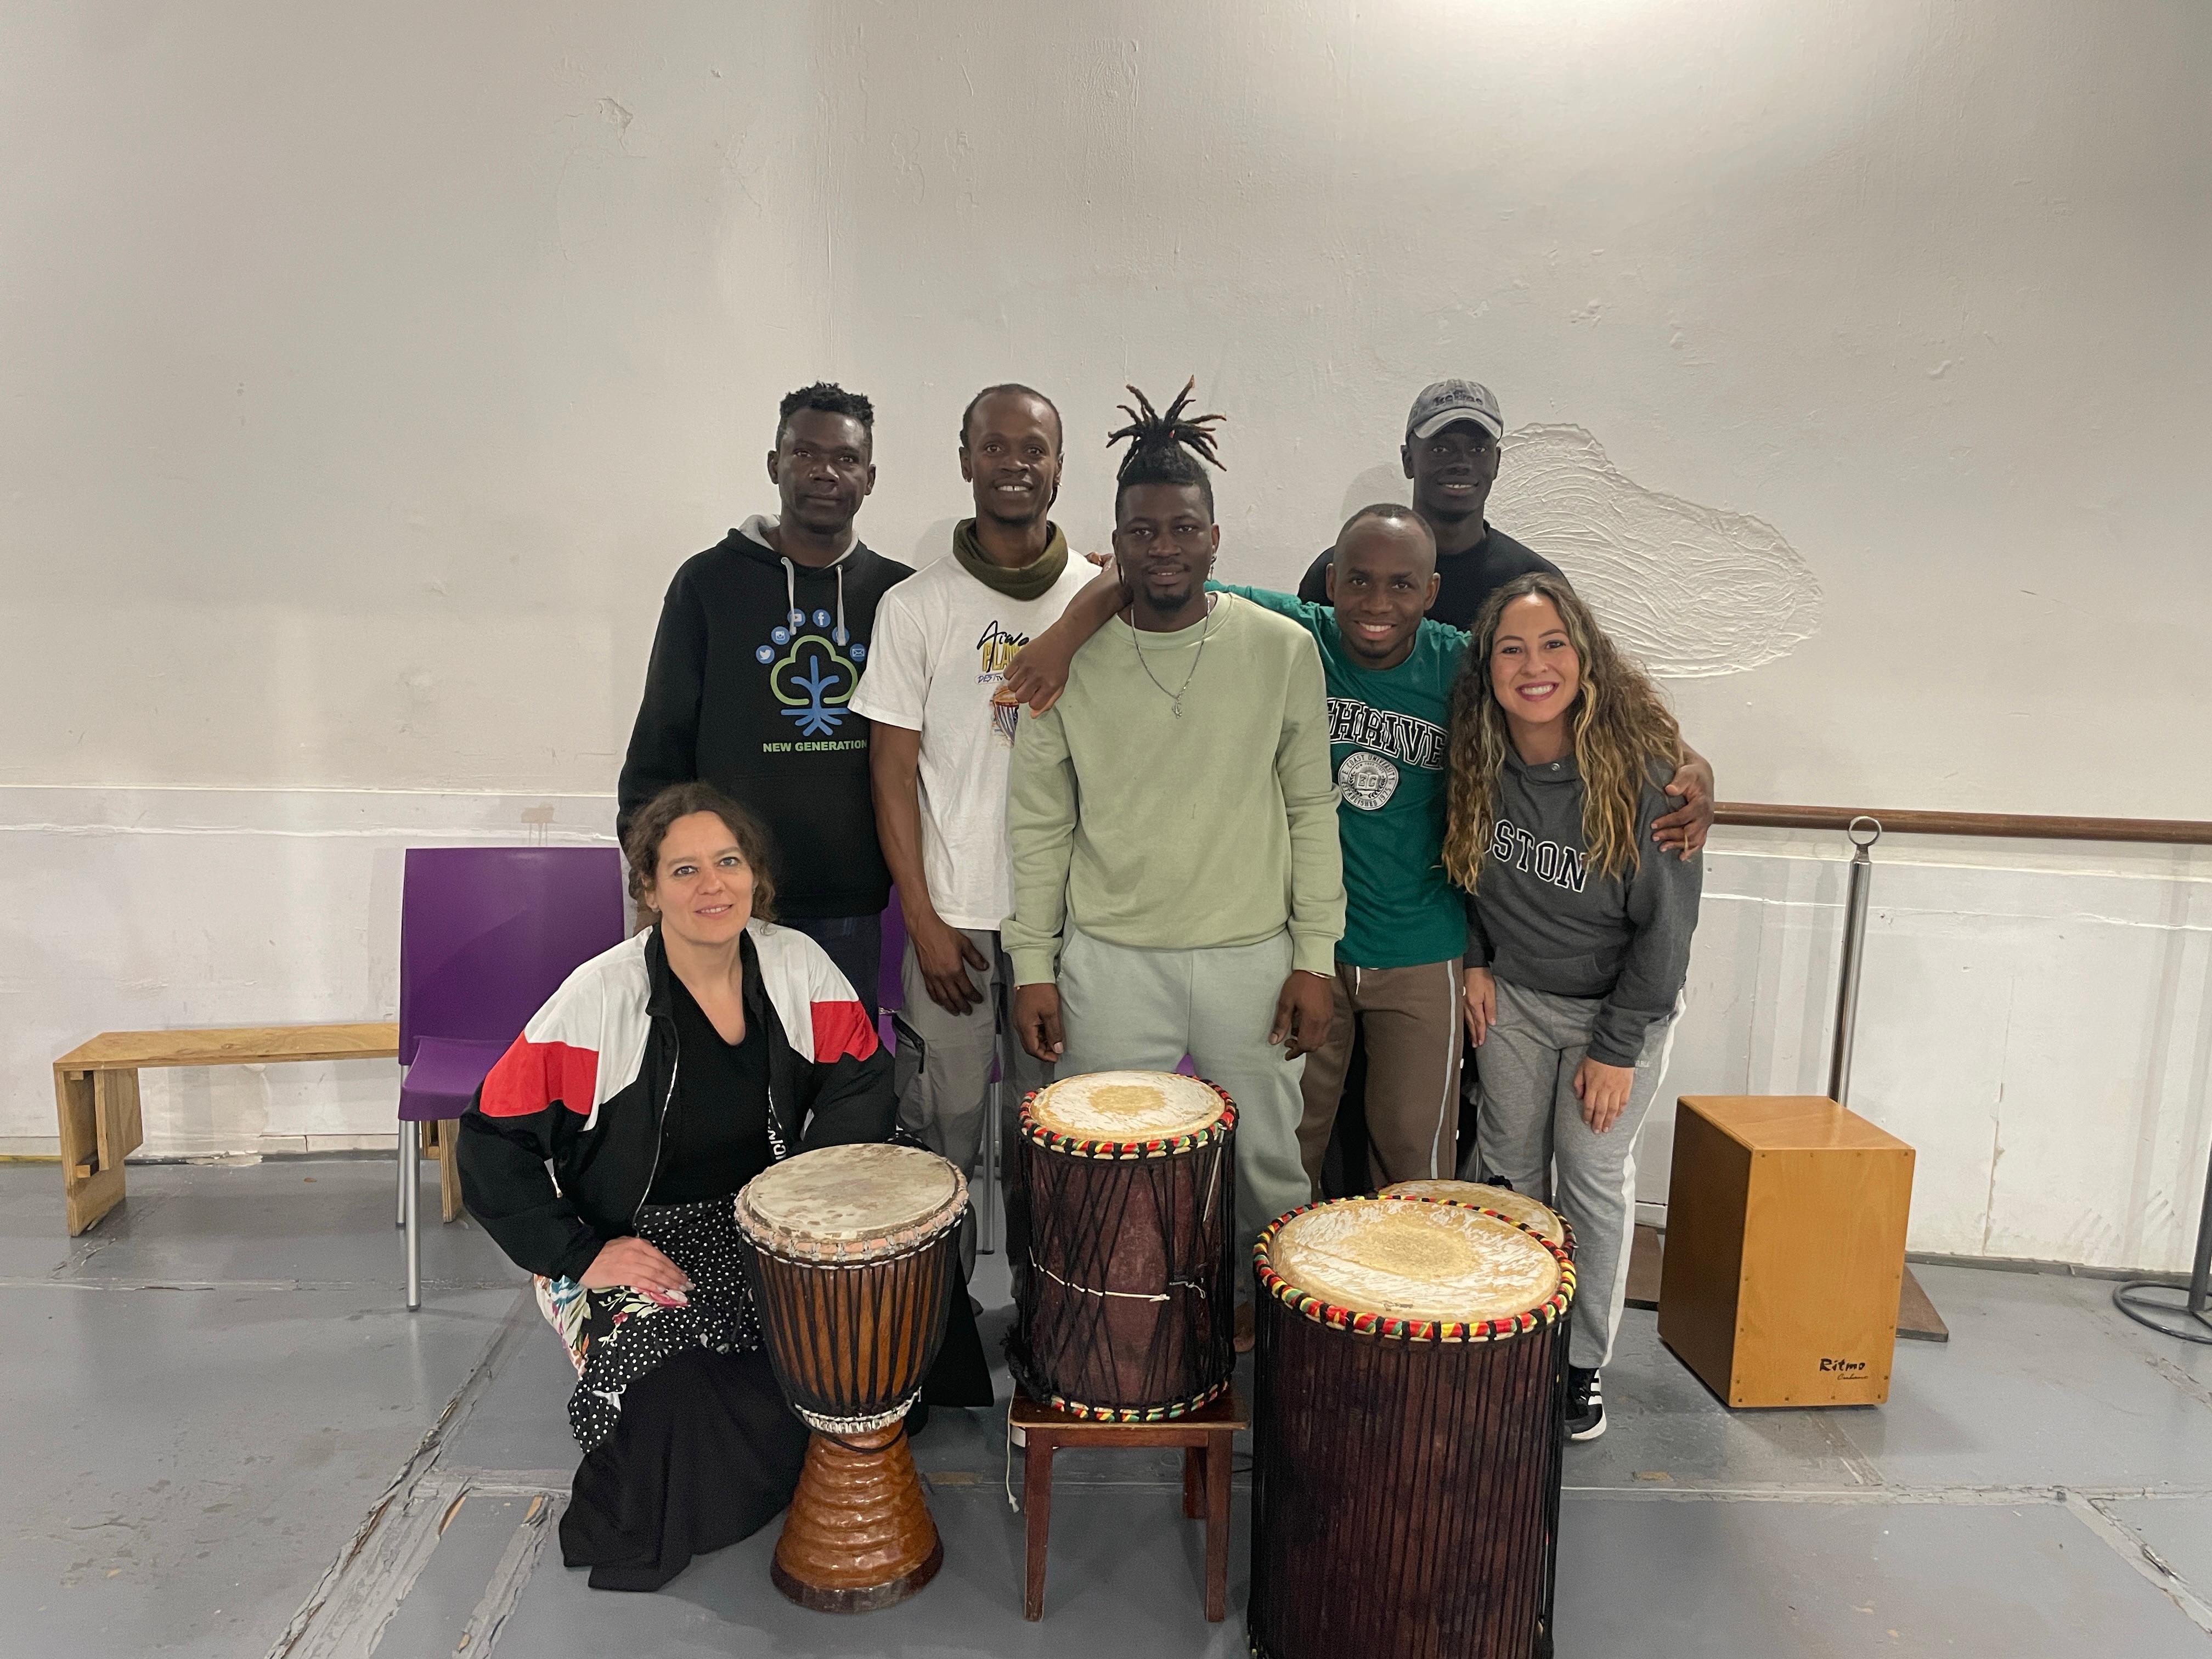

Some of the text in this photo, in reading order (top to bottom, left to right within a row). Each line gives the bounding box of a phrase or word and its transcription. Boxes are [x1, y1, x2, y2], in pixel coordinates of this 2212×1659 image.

[763, 740, 867, 752] NEW GENERATION
[1346, 754, 1365, 769] COAST
[1368, 755, 1395, 781] UNIVERSITY
[1378, 787, 1391, 802] 1975
[1485, 819, 1589, 893] STON
[1819, 1358, 1865, 1372] Ritmo
